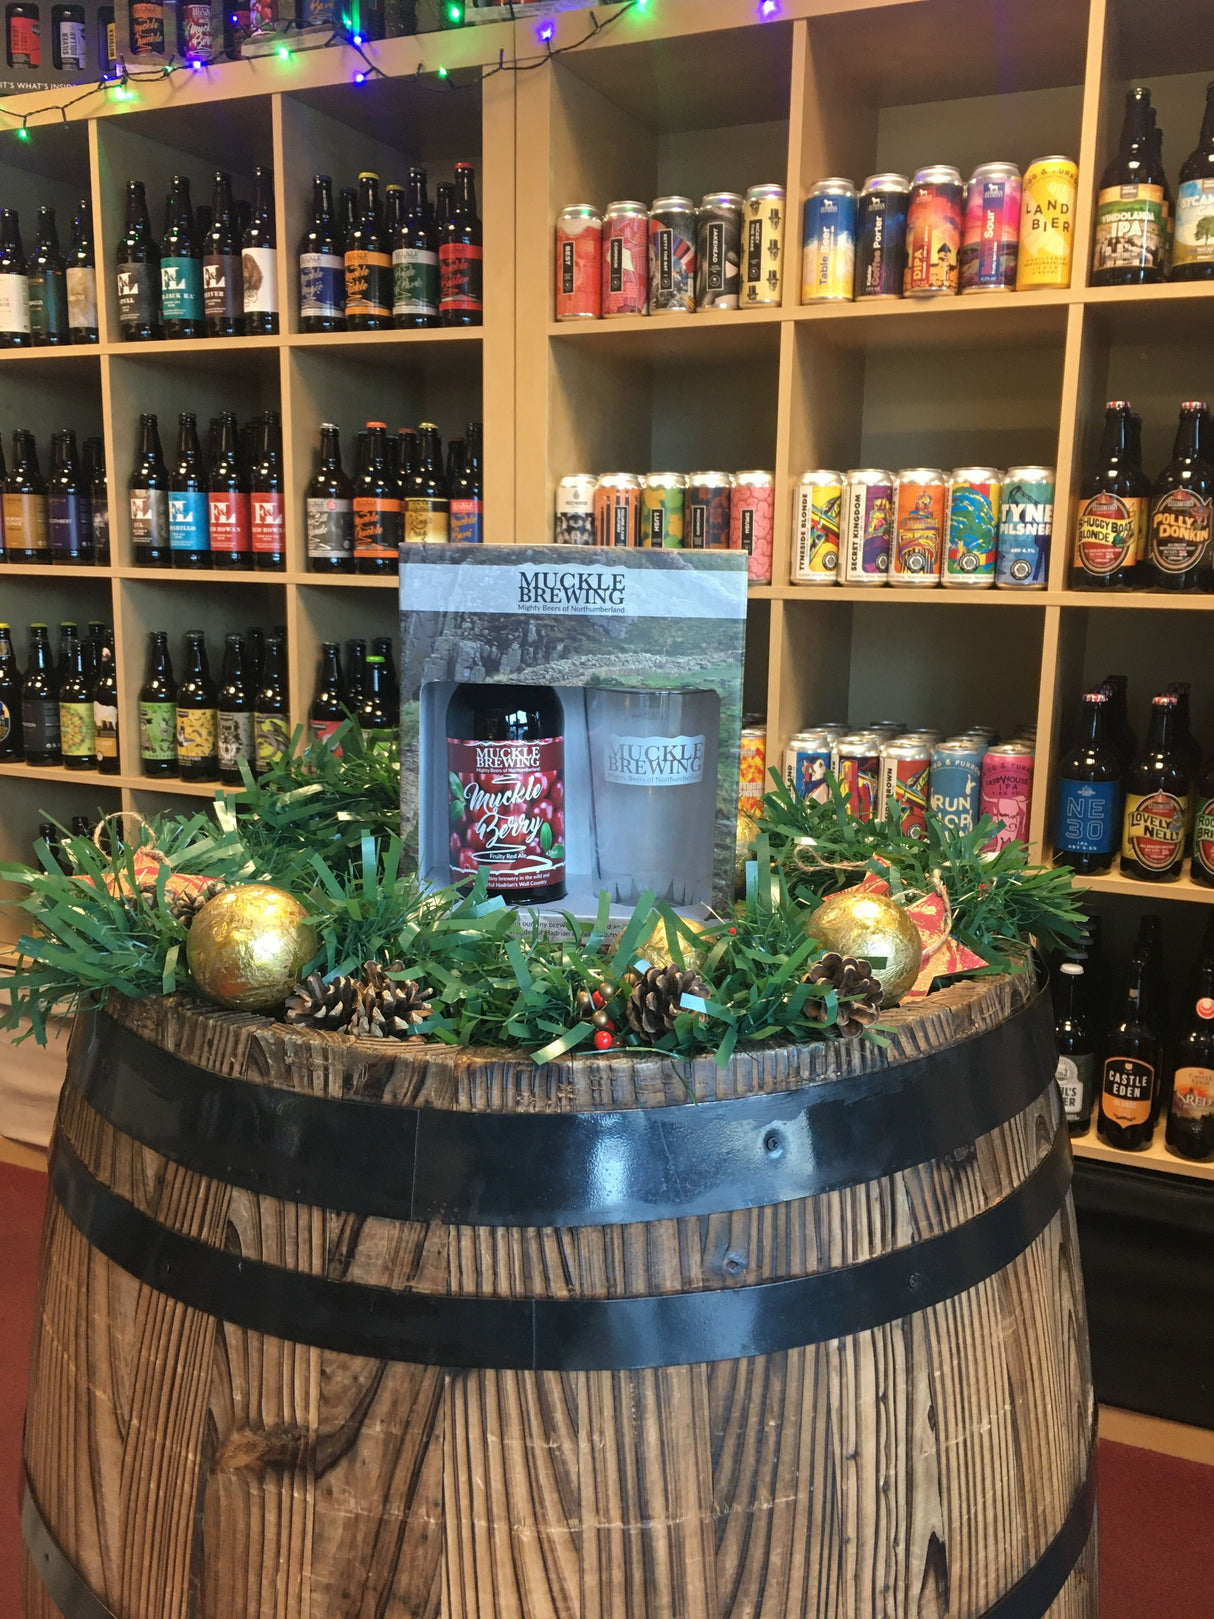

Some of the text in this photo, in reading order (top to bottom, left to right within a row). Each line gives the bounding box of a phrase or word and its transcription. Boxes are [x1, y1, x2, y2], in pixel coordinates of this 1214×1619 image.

[1026, 200, 1070, 215] LAND
[984, 210, 995, 238] Sour
[1032, 217, 1071, 233] BIER
[1101, 211, 1155, 223] VINDOLANDA
[873, 216, 883, 249] Porter
[1111, 221, 1143, 238] IPA
[819, 226, 831, 286] Table Beer
[913, 249, 923, 279] DIPA
[871, 250, 881, 285] Coffee
[853, 494, 861, 539] KINGDOM
[1001, 503, 1053, 523] TYNE
[1153, 513, 1195, 529] POLLY
[1000, 523, 1052, 536] PILSNER
[1111, 520, 1134, 534] BOAT
[1160, 525, 1209, 542] DONKIN
[518, 571, 626, 591] MUCKLE
[518, 586, 625, 605] BREWING
[518, 604, 541, 612] Mighty
[476, 747, 540, 759] MUCKLE
[608, 742, 704, 761] MUCKLE
[476, 756, 540, 768] BREWING
[608, 755, 701, 776] BREWING
[985, 776, 1028, 787] FARMHOUSE
[463, 775, 543, 814] Muckle
[934, 795, 971, 812] RUN
[1067, 797, 1105, 818] NE
[1131, 813, 1172, 829] LOVELY
[475, 813, 544, 849] Berry
[1065, 819, 1104, 841] 30
[1144, 828, 1180, 842] NELLY
[1109, 1070, 1148, 1087] CASTLE
[1113, 1084, 1140, 1098] EDEN
